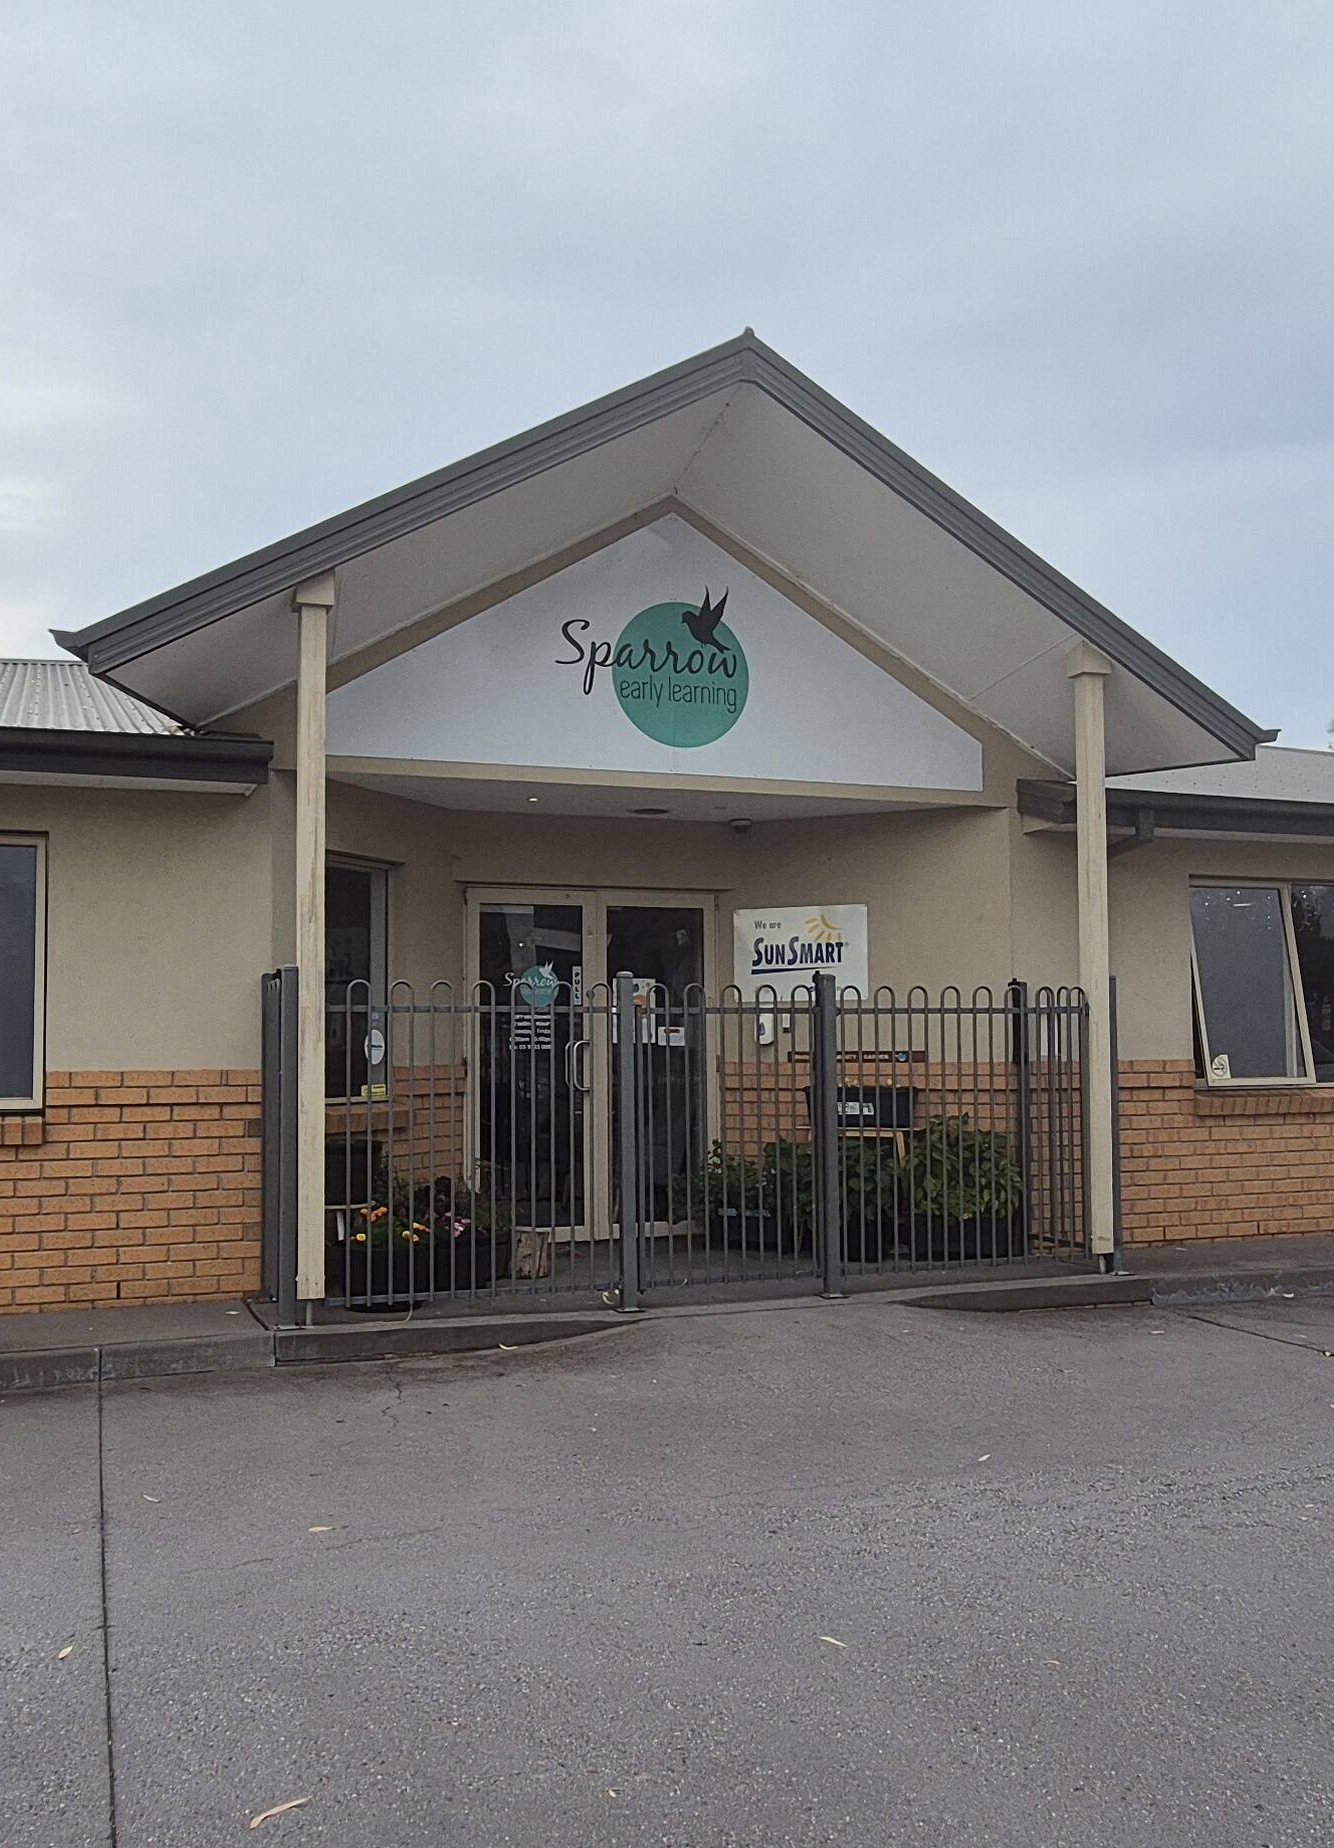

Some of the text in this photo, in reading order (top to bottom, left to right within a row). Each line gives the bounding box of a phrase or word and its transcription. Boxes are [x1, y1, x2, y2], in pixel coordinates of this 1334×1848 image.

[555, 619, 737, 695] Sparrow
[620, 675, 736, 714] early learning
[754, 920, 782, 929] We are
